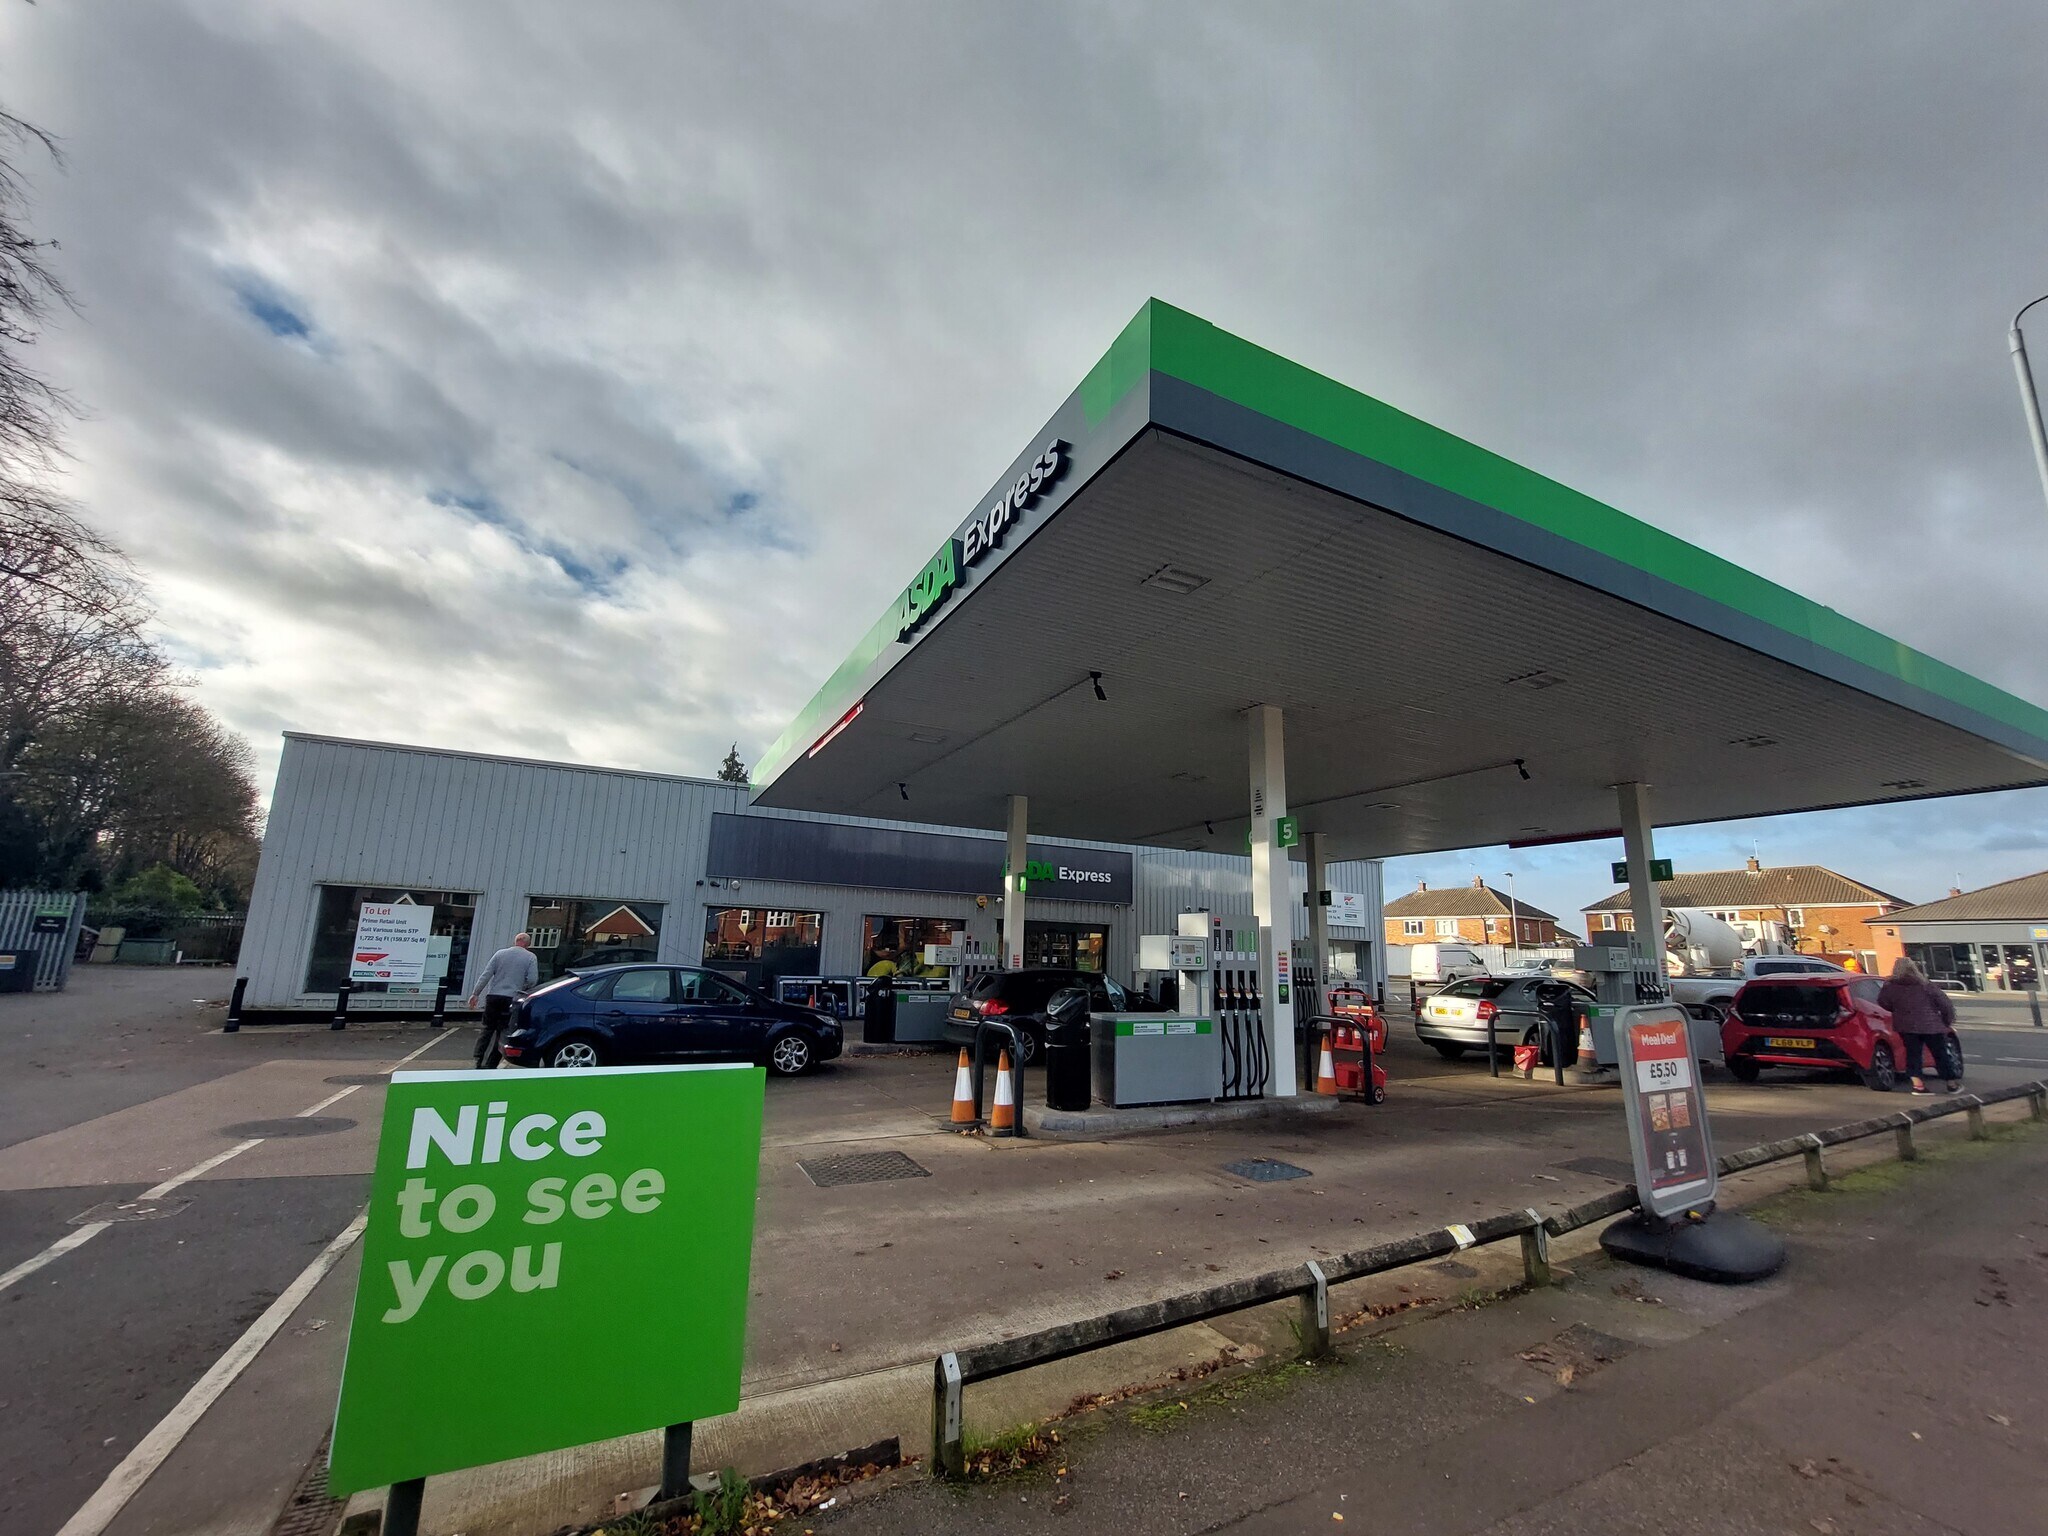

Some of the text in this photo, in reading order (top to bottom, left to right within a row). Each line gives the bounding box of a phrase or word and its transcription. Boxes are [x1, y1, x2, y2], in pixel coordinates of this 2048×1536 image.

[895, 438, 1059, 634] ASDA Express
[1283, 823, 1293, 840] 5
[1001, 859, 1112, 883] DA Express
[1617, 868, 1627, 879] 2
[1659, 865, 1666, 877] 1
[364, 906, 391, 916] To Let
[1641, 1032, 1677, 1046] Meal Deal
[1650, 1061, 1678, 1079] £5.50
[406, 1100, 607, 1170] Nice
[397, 1167, 666, 1239] to see
[381, 1241, 563, 1324] you
